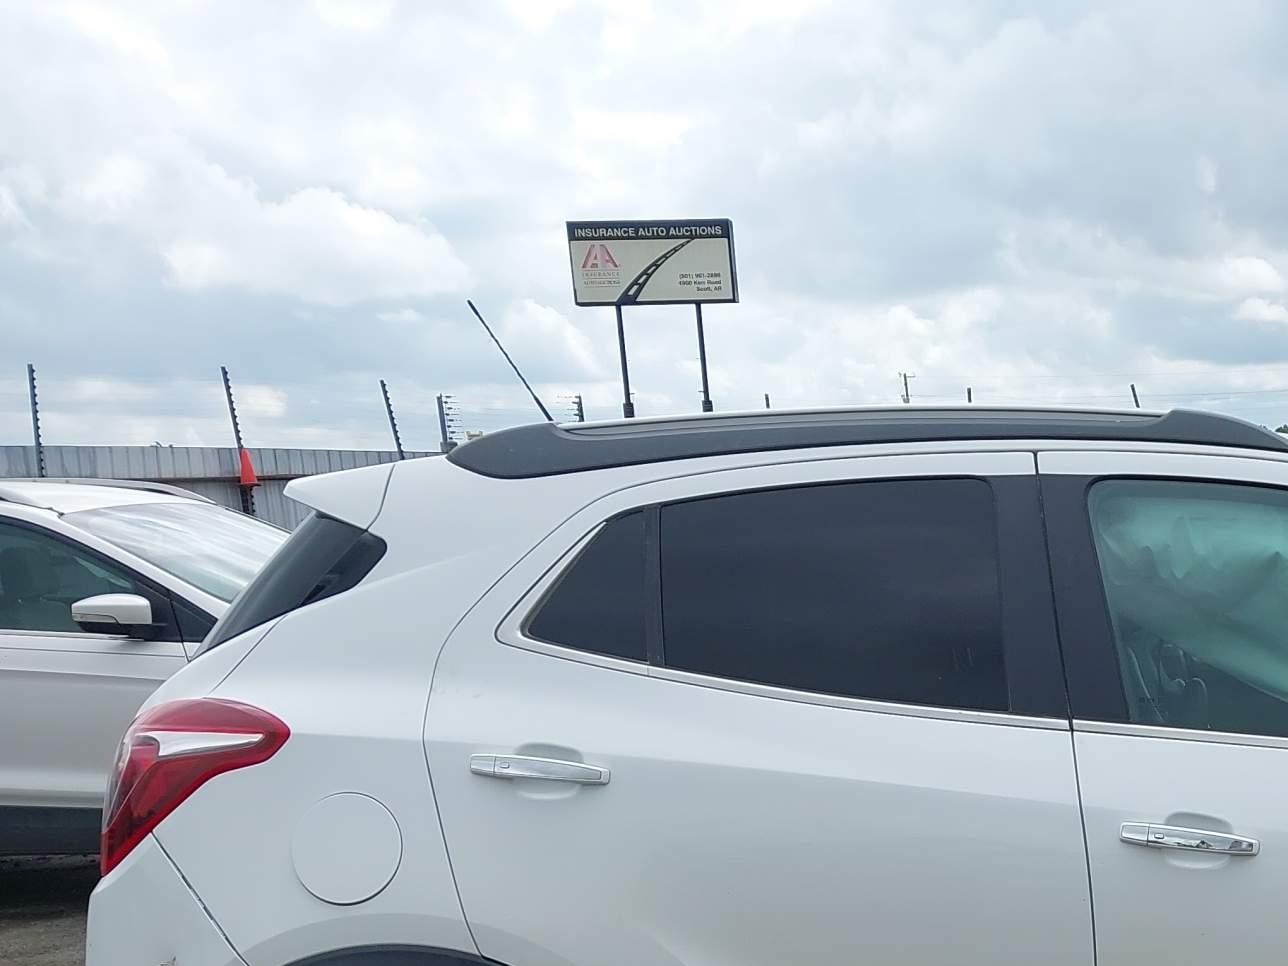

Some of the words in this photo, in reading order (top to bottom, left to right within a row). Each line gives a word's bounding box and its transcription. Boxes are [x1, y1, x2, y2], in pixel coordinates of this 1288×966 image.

[574, 228, 635, 237] INSURANCE
[638, 227, 667, 236] AUTO
[669, 225, 722, 235] AUCTIONS
